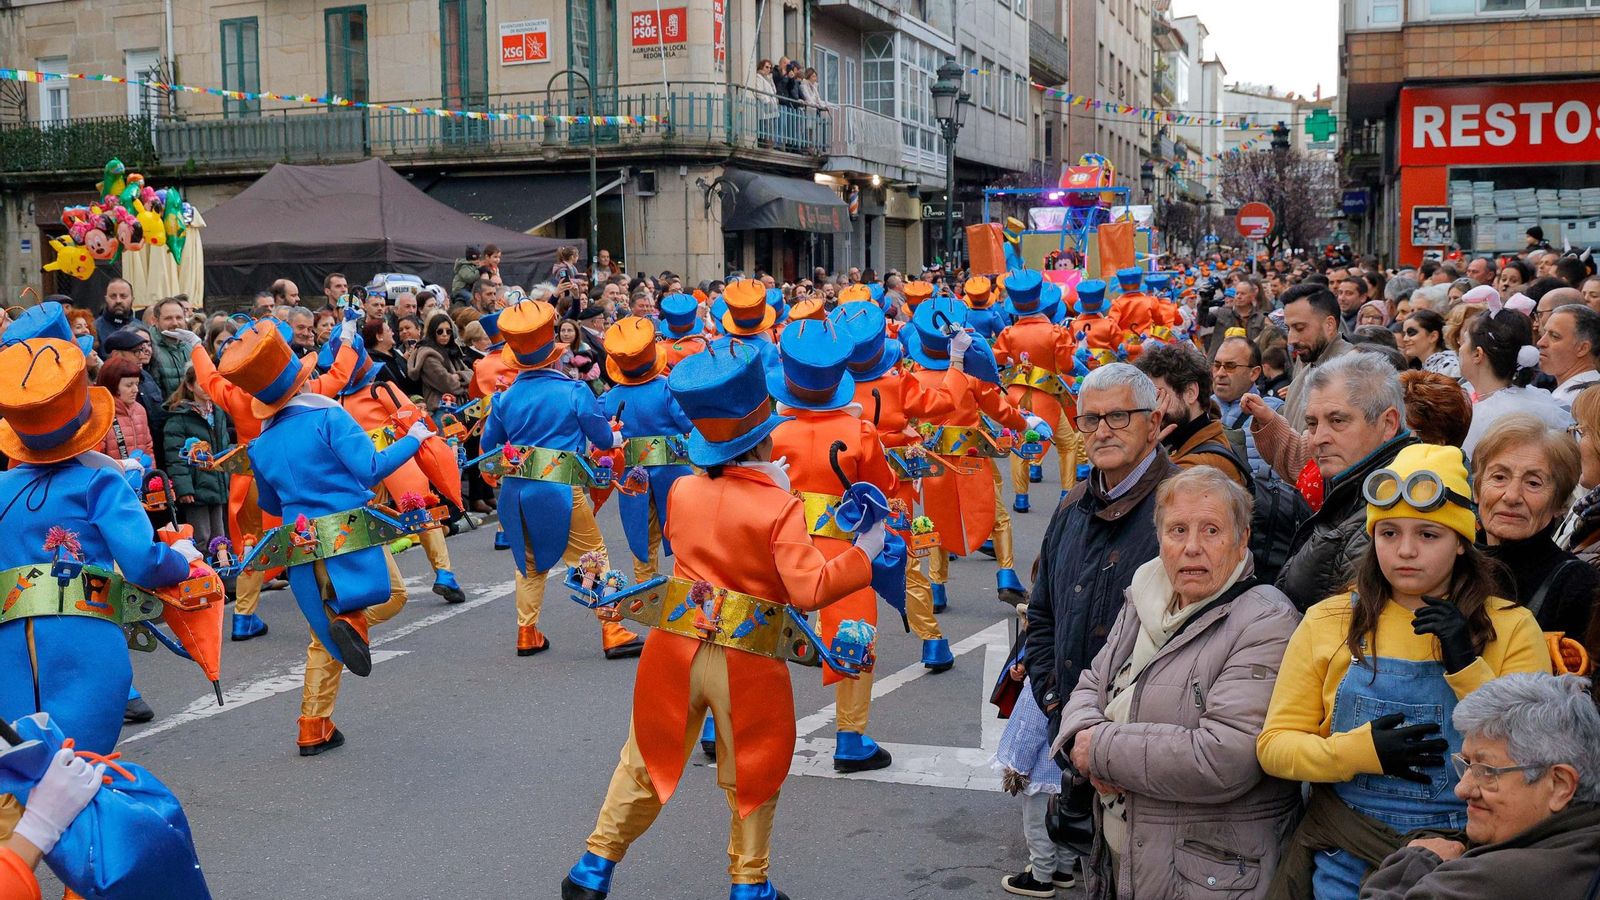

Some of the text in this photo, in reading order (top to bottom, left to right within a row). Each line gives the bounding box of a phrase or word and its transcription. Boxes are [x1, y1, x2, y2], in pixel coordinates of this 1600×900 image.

[633, 14, 652, 27] PSG
[633, 26, 657, 39] PSOE
[504, 46, 523, 58] XSG
[1412, 100, 1600, 148] RESTO
[1071, 173, 1091, 182] 18
